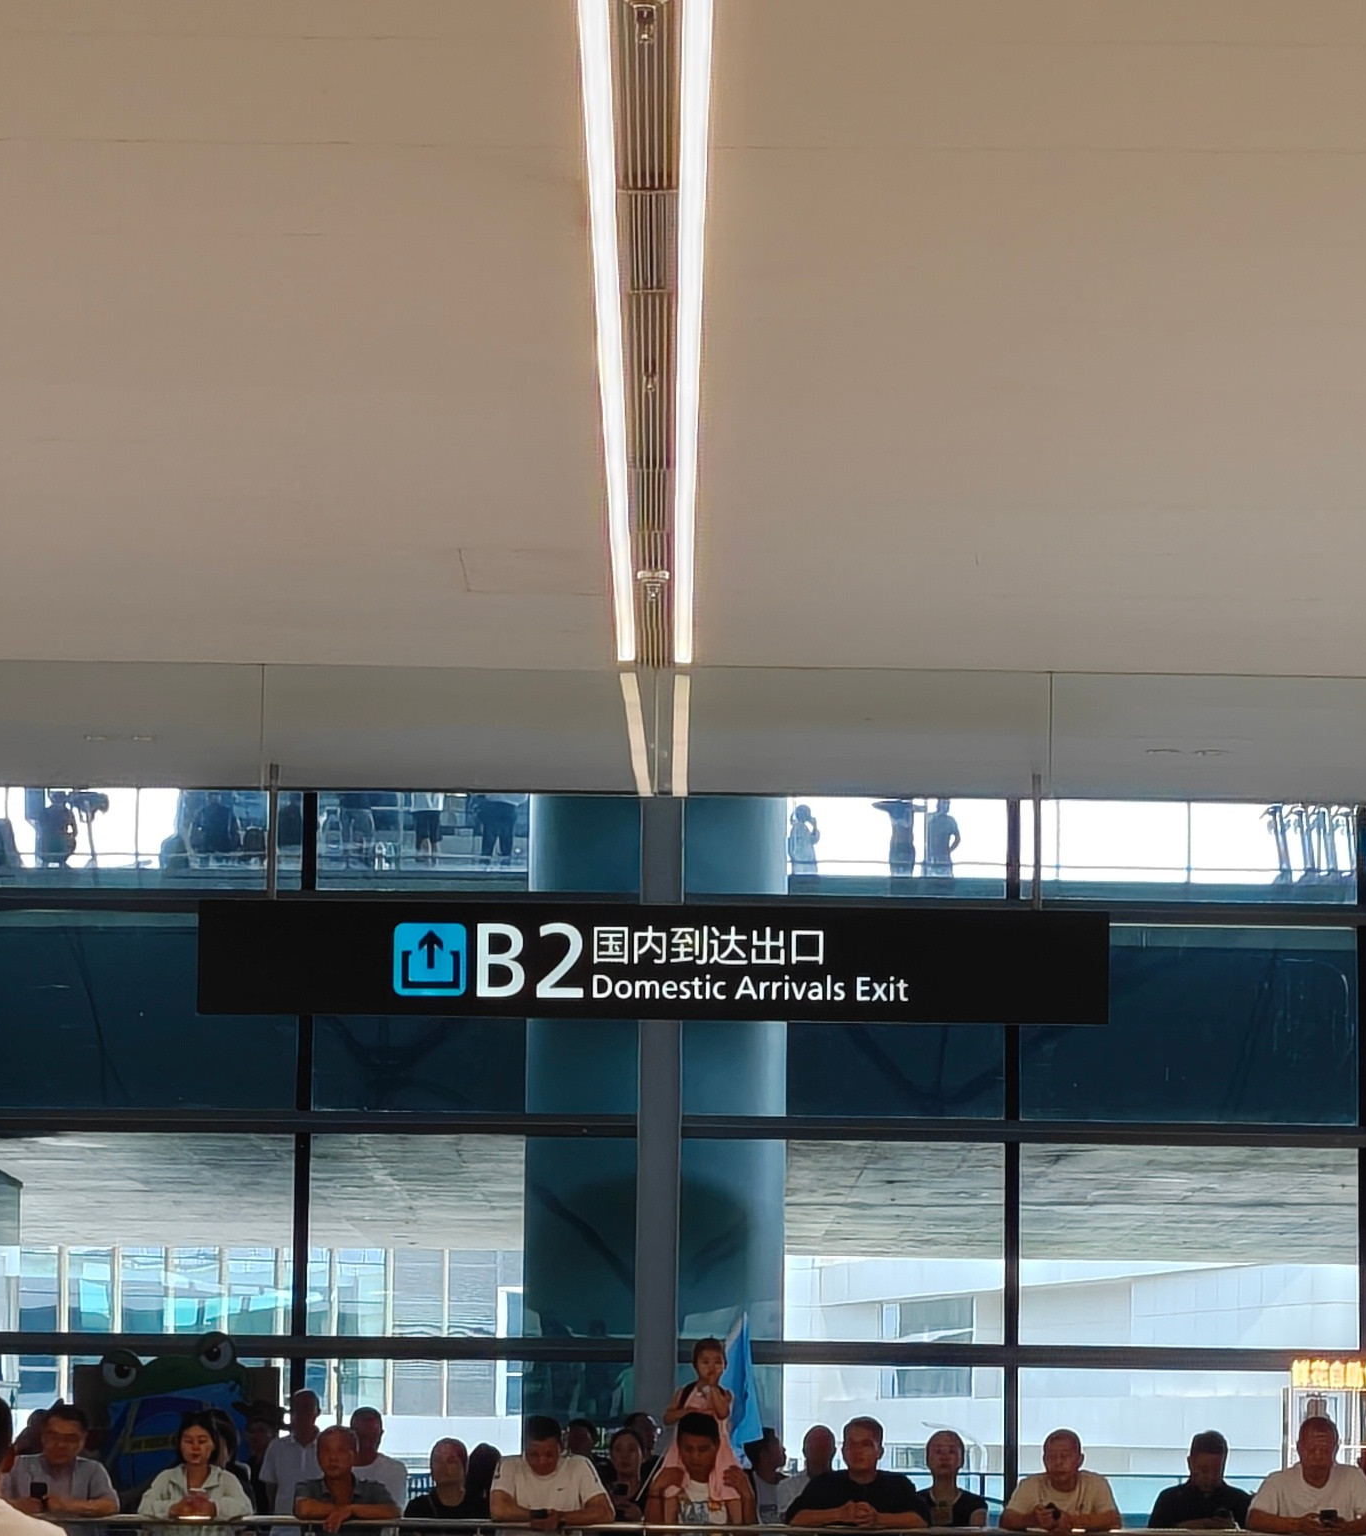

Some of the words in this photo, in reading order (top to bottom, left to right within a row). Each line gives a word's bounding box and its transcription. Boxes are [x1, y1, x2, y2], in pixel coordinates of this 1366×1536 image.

[477, 923, 584, 998] B2
[594, 926, 824, 965] 国内到达出口
[593, 974, 726, 999] Domestic
[735, 975, 845, 1000] Arrivals
[857, 976, 908, 1001] Exit
